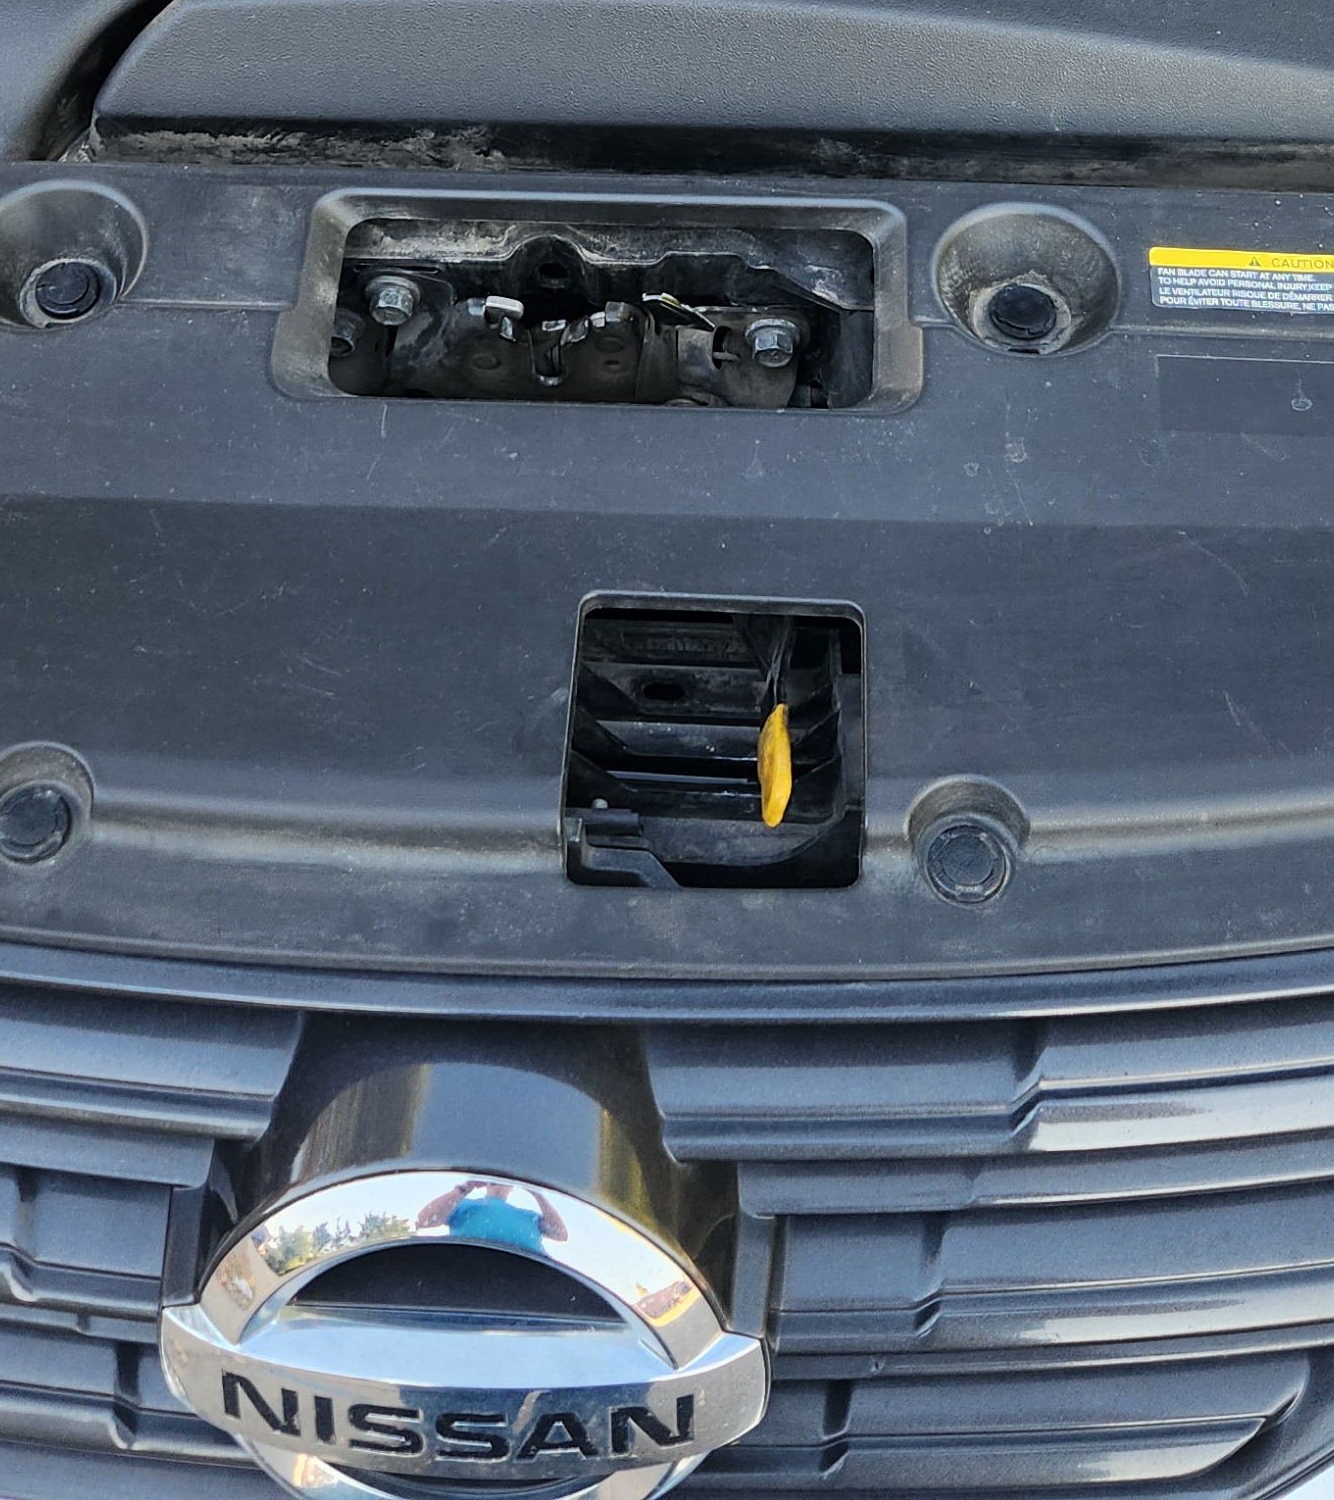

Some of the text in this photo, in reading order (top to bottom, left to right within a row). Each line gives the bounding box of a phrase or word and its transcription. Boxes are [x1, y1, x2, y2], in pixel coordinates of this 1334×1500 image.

[1271, 257, 1334, 269] CAUTION
[1178, 268, 1207, 276] BLADE
[1209, 269, 1228, 277] CAN
[1230, 270, 1258, 278] START
[1198, 278, 1225, 286] AVOID
[1228, 280, 1276, 289] PERSONAL
[1172, 288, 1230, 297] VENTILATEUR
[1232, 289, 1267, 298] RISQUE
[1283, 291, 1332, 301] DÉMARRER
[1188, 296, 1219, 305] ÉVITER
[1221, 298, 1250, 306] TOUTE
[1251, 300, 1301, 310] BLESSURE,
[1302, 303, 1315, 311] NE
[221, 1368, 696, 1463] NISSAN
